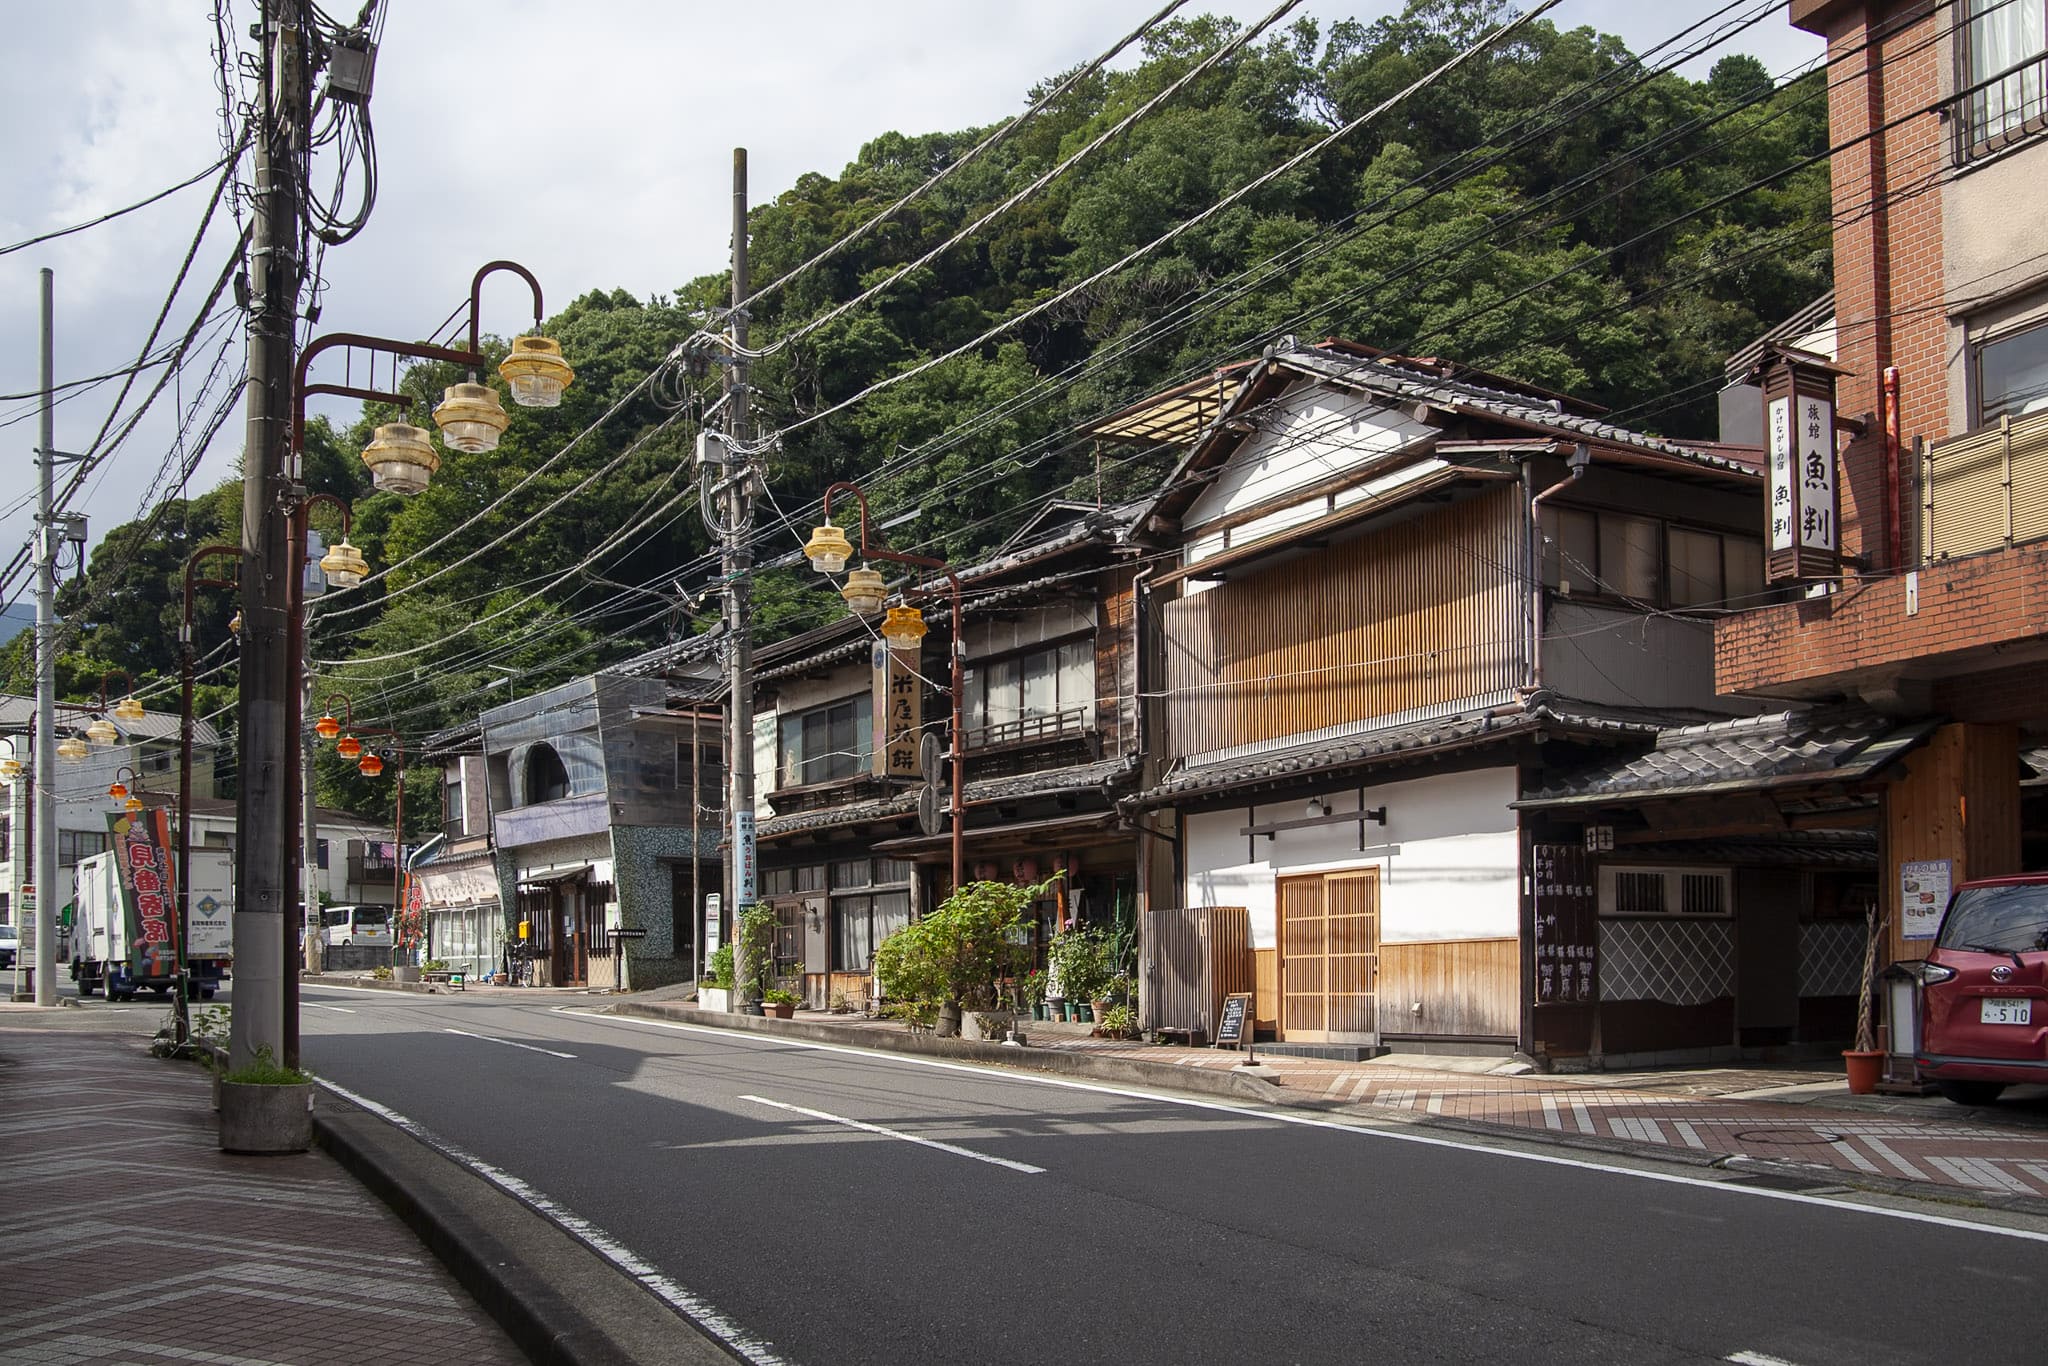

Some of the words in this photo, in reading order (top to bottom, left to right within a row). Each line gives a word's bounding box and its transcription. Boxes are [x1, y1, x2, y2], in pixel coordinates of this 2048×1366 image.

[1775, 407, 1785, 471] かけながしの宿
[1807, 403, 1821, 440] 旅館
